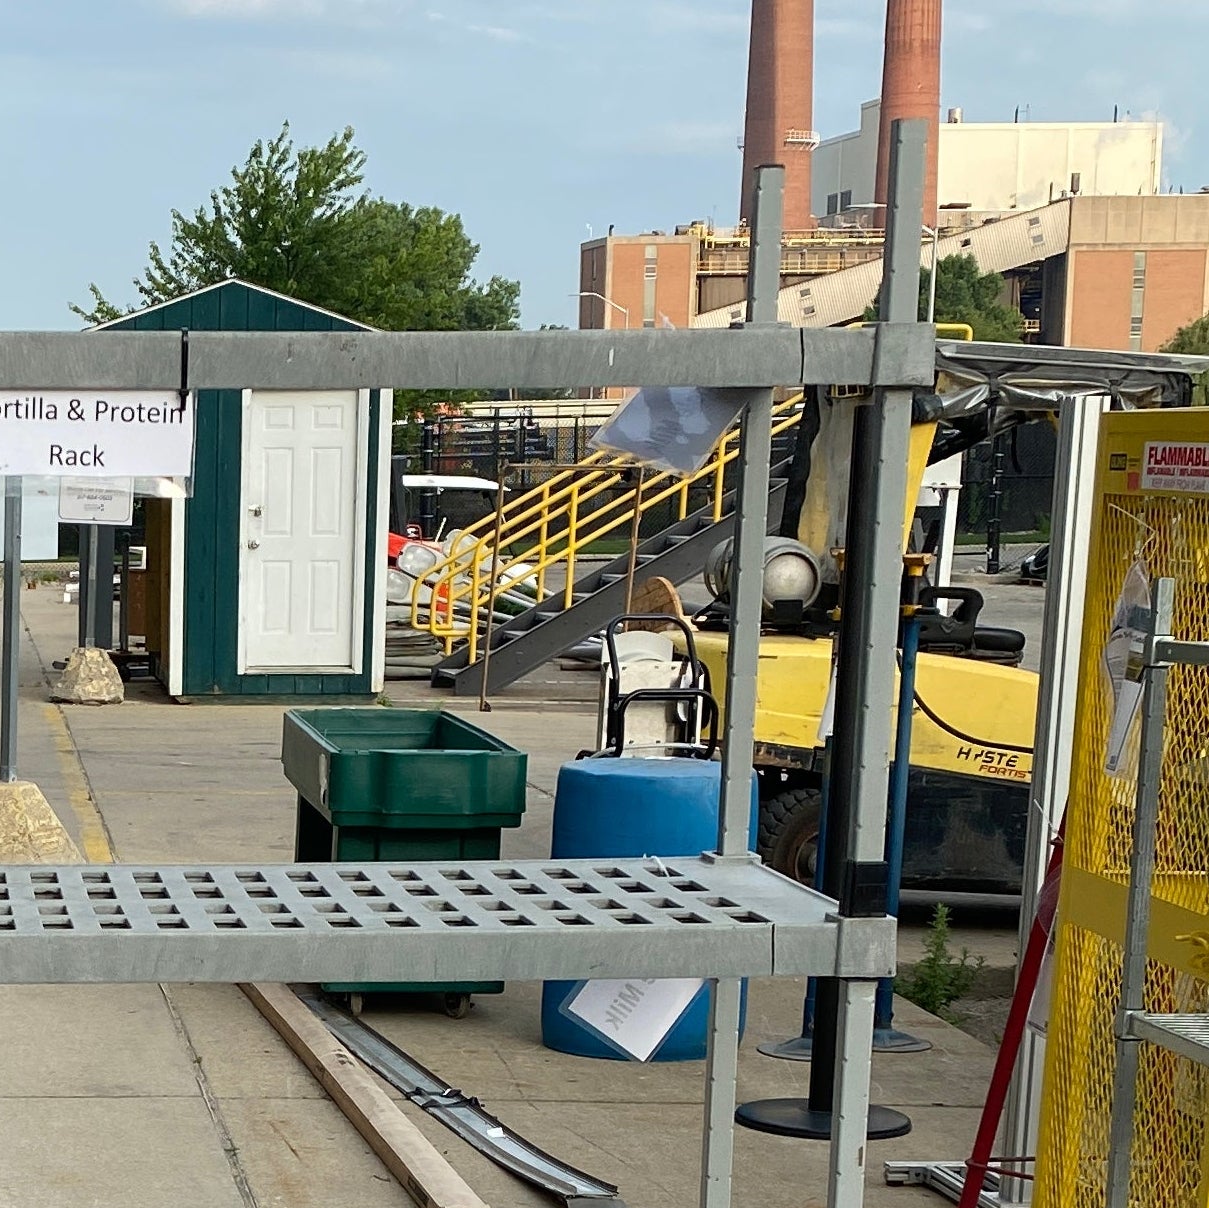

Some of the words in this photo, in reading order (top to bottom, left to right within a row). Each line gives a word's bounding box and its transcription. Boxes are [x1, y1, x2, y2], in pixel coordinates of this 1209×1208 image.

[67, 399, 85, 422] &
[95, 400, 184, 424] Protein
[49, 444, 105, 467] Rack
[1148, 446, 1209, 467] FLAMMABL
[978, 764, 1028, 778] FORTIS
